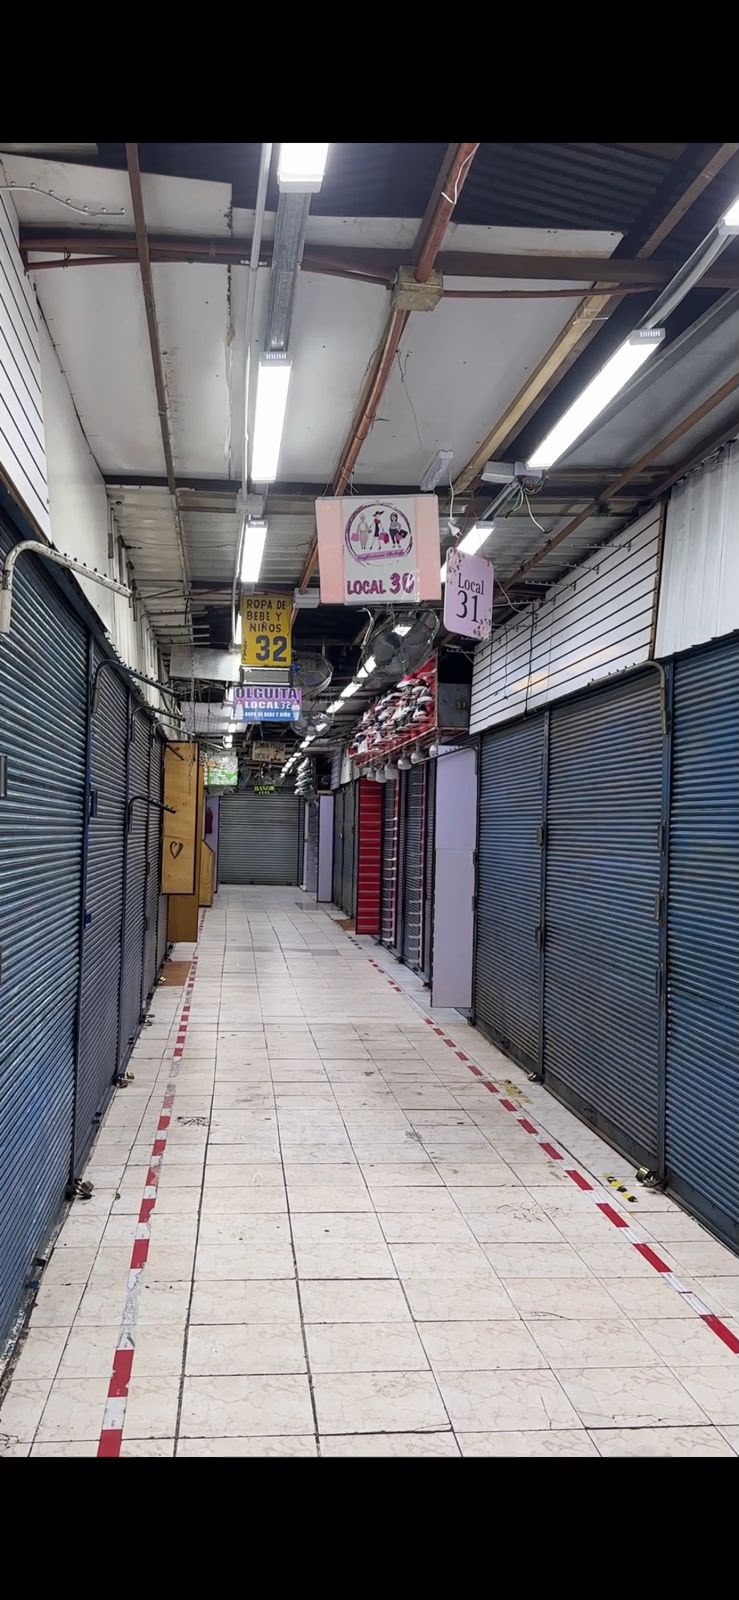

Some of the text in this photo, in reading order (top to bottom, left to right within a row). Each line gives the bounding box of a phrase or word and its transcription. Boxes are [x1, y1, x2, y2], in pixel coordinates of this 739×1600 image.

[347, 572, 415, 594] LOCAL 30
[458, 573, 484, 595] Local
[246, 599, 287, 610] ROPA DE
[456, 590, 482, 622] 31
[246, 611, 282, 621] BEBE Y
[249, 621, 282, 633] NIÑOS
[255, 635, 288, 662] 32
[235, 687, 297, 699] OLGUITA
[244, 701, 291, 709] LOCAL 32
